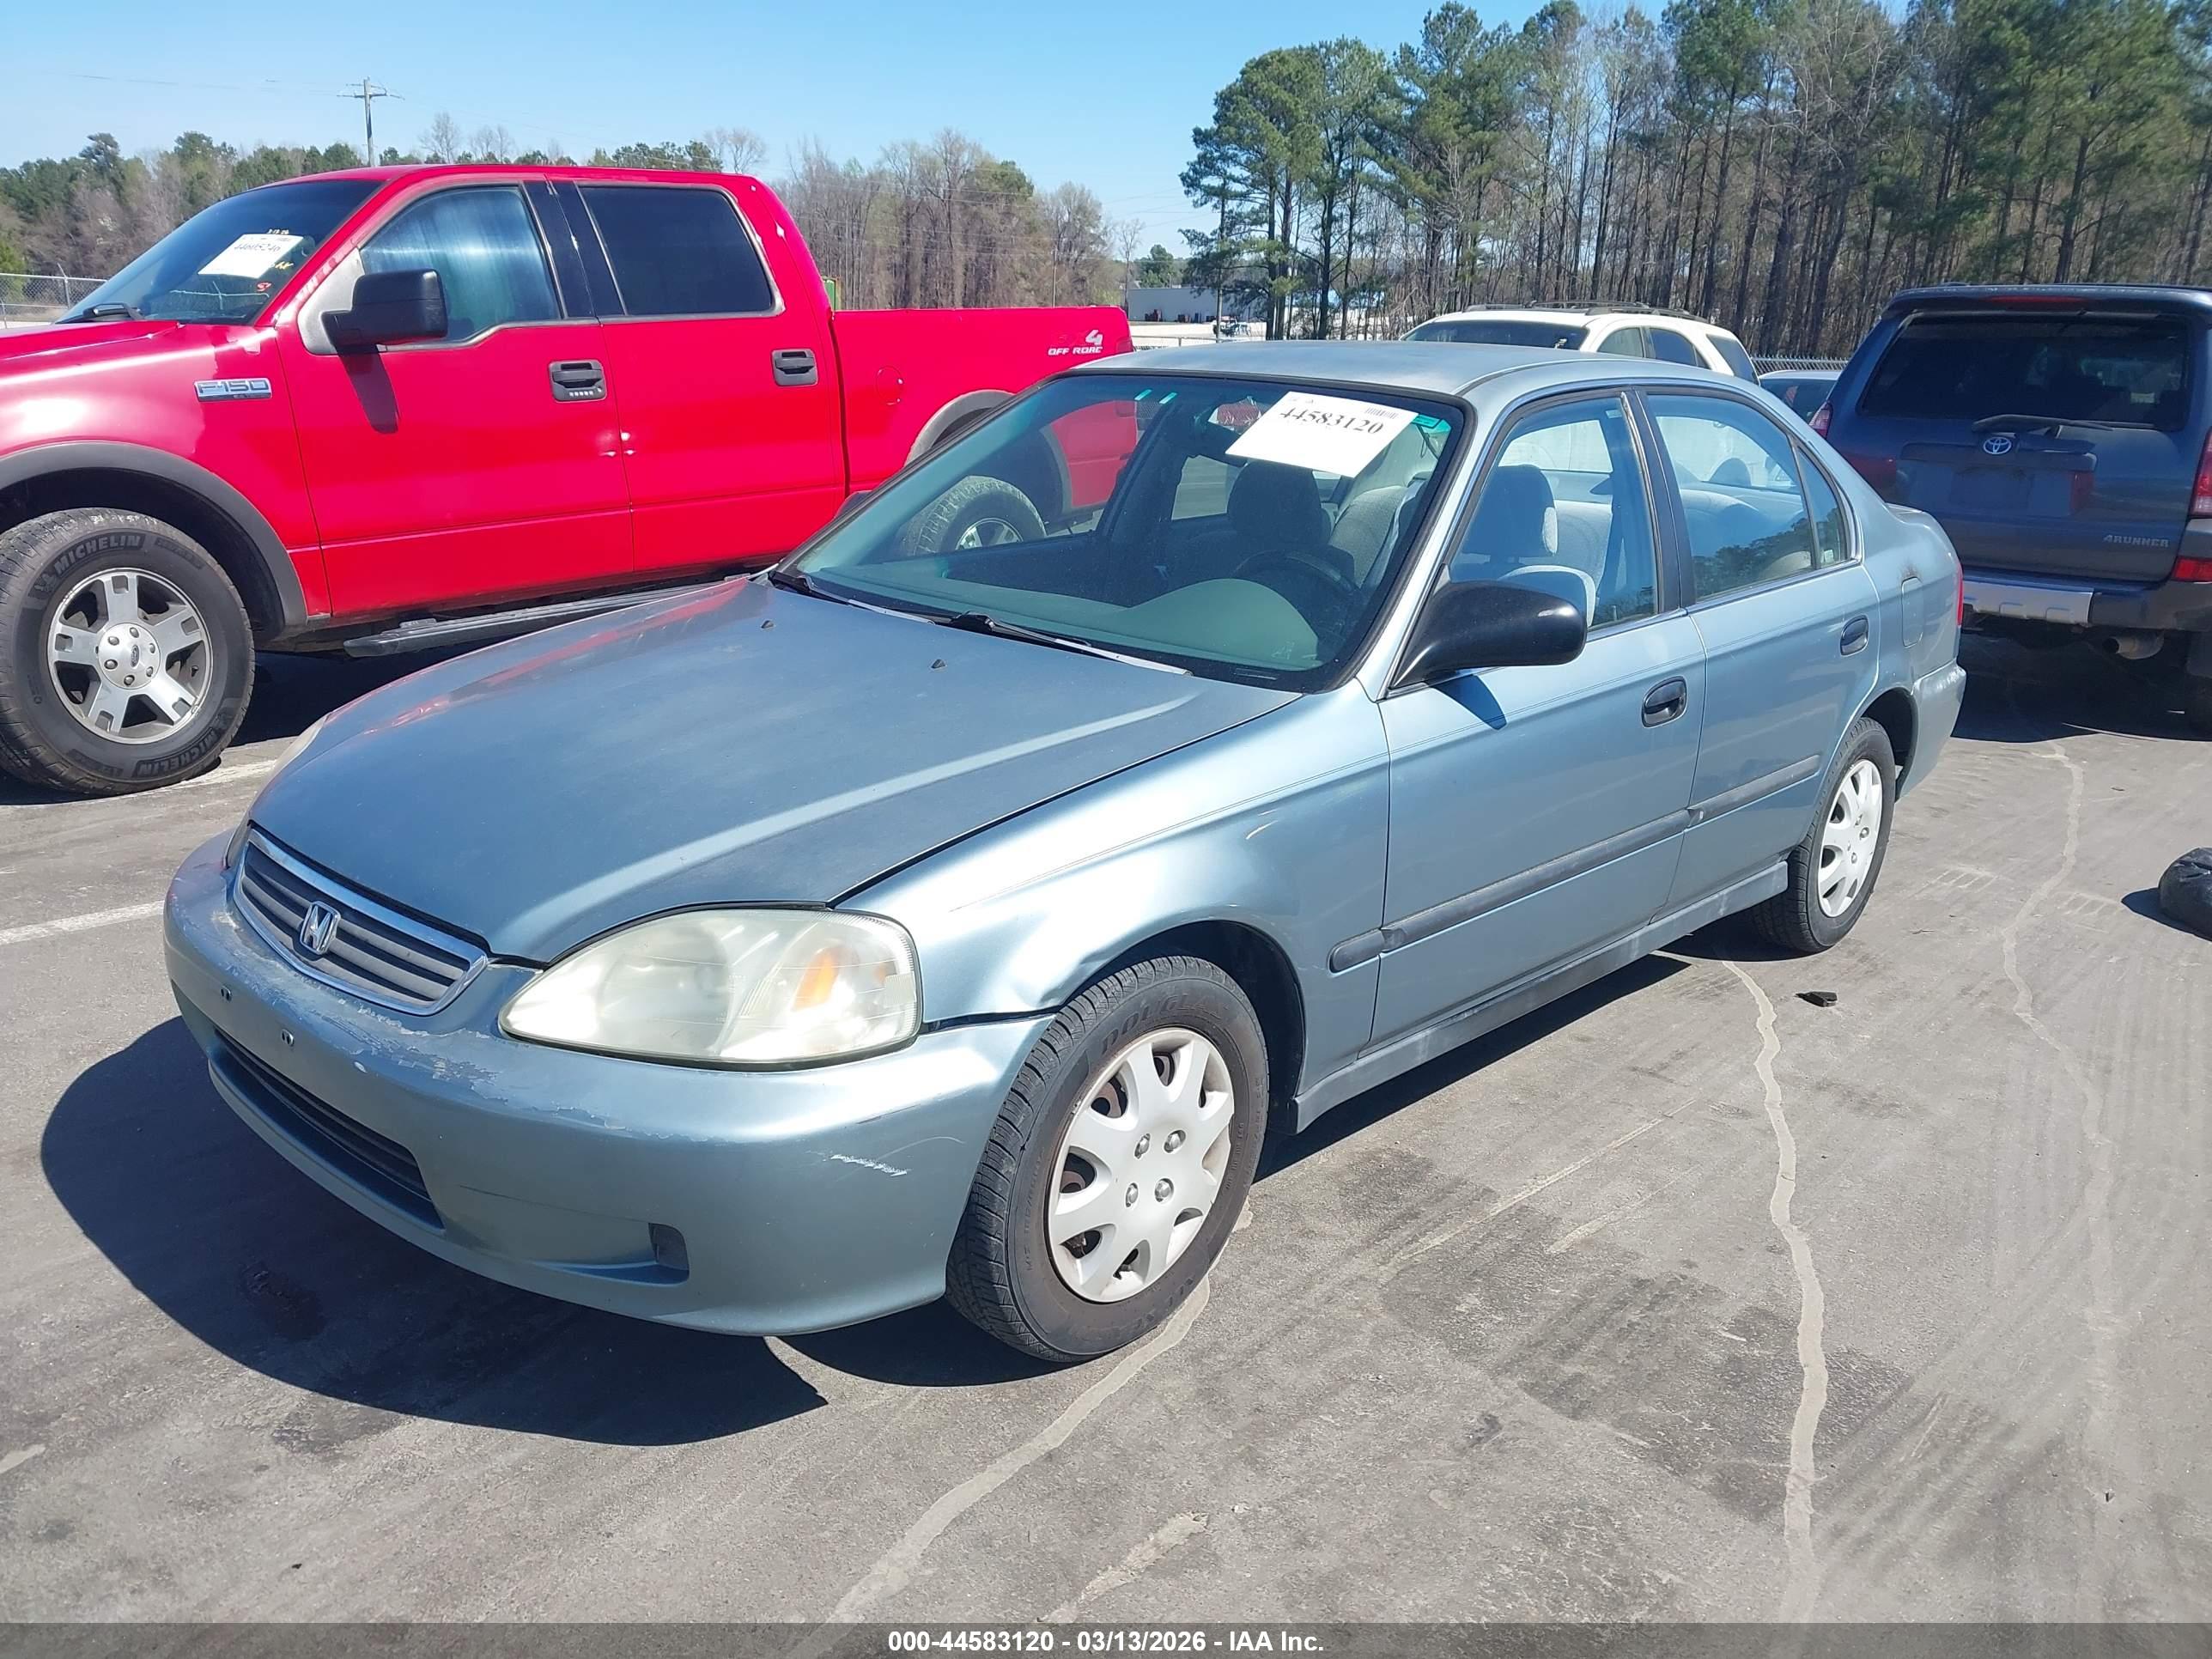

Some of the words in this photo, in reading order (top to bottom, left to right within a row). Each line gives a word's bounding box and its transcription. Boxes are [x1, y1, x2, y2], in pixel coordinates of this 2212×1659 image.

[1048, 347, 1069, 356] OFF
[1072, 346, 1103, 355] ROAD
[197, 379, 270, 394] F-150
[1279, 407, 1383, 434] 44583120
[2102, 534, 2169, 548] 4RUNNER
[53, 535, 141, 575] MICHELIN
